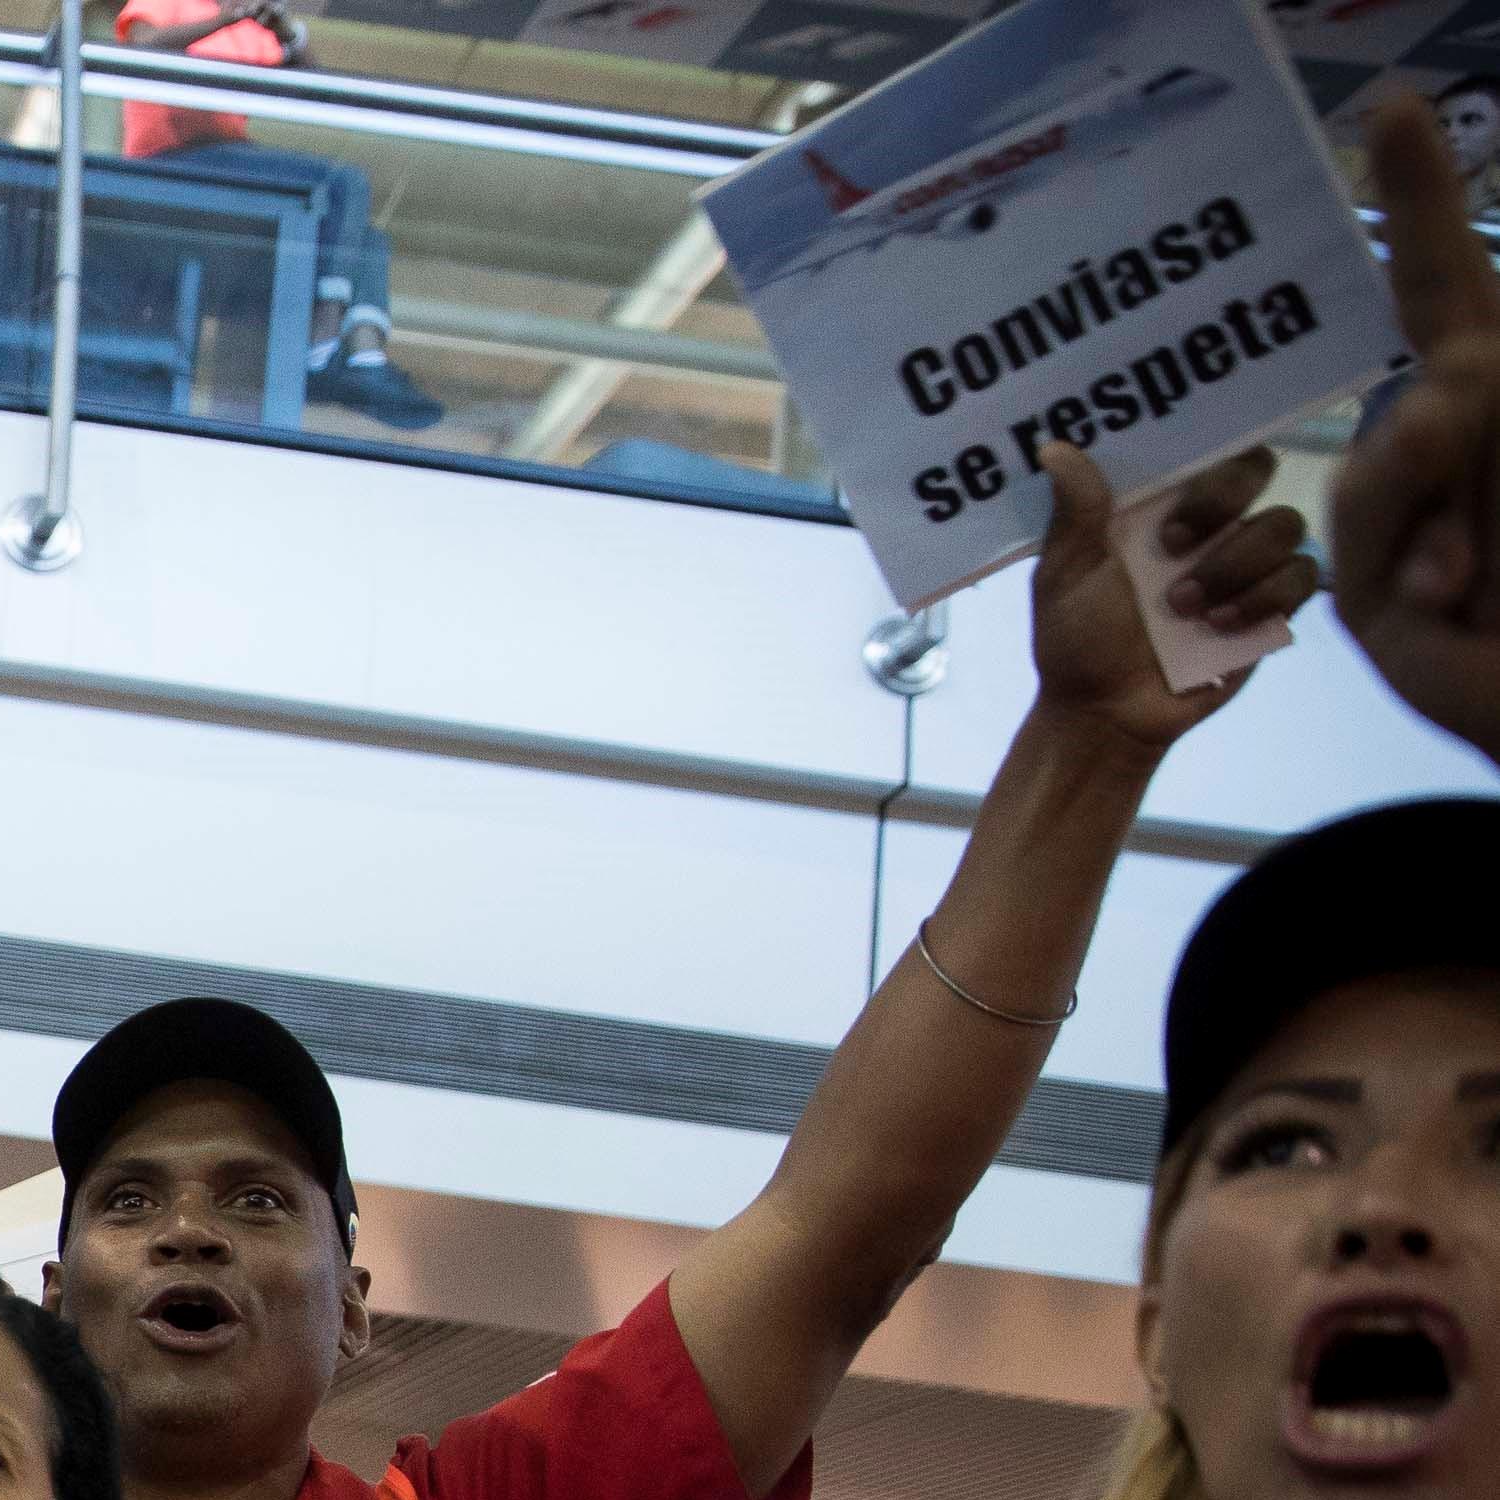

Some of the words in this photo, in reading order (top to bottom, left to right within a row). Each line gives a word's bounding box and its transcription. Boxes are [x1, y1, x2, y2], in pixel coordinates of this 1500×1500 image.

[902, 196, 1255, 417] Conviasa
[912, 445, 1006, 522] se
[1010, 281, 1318, 474] respeta
